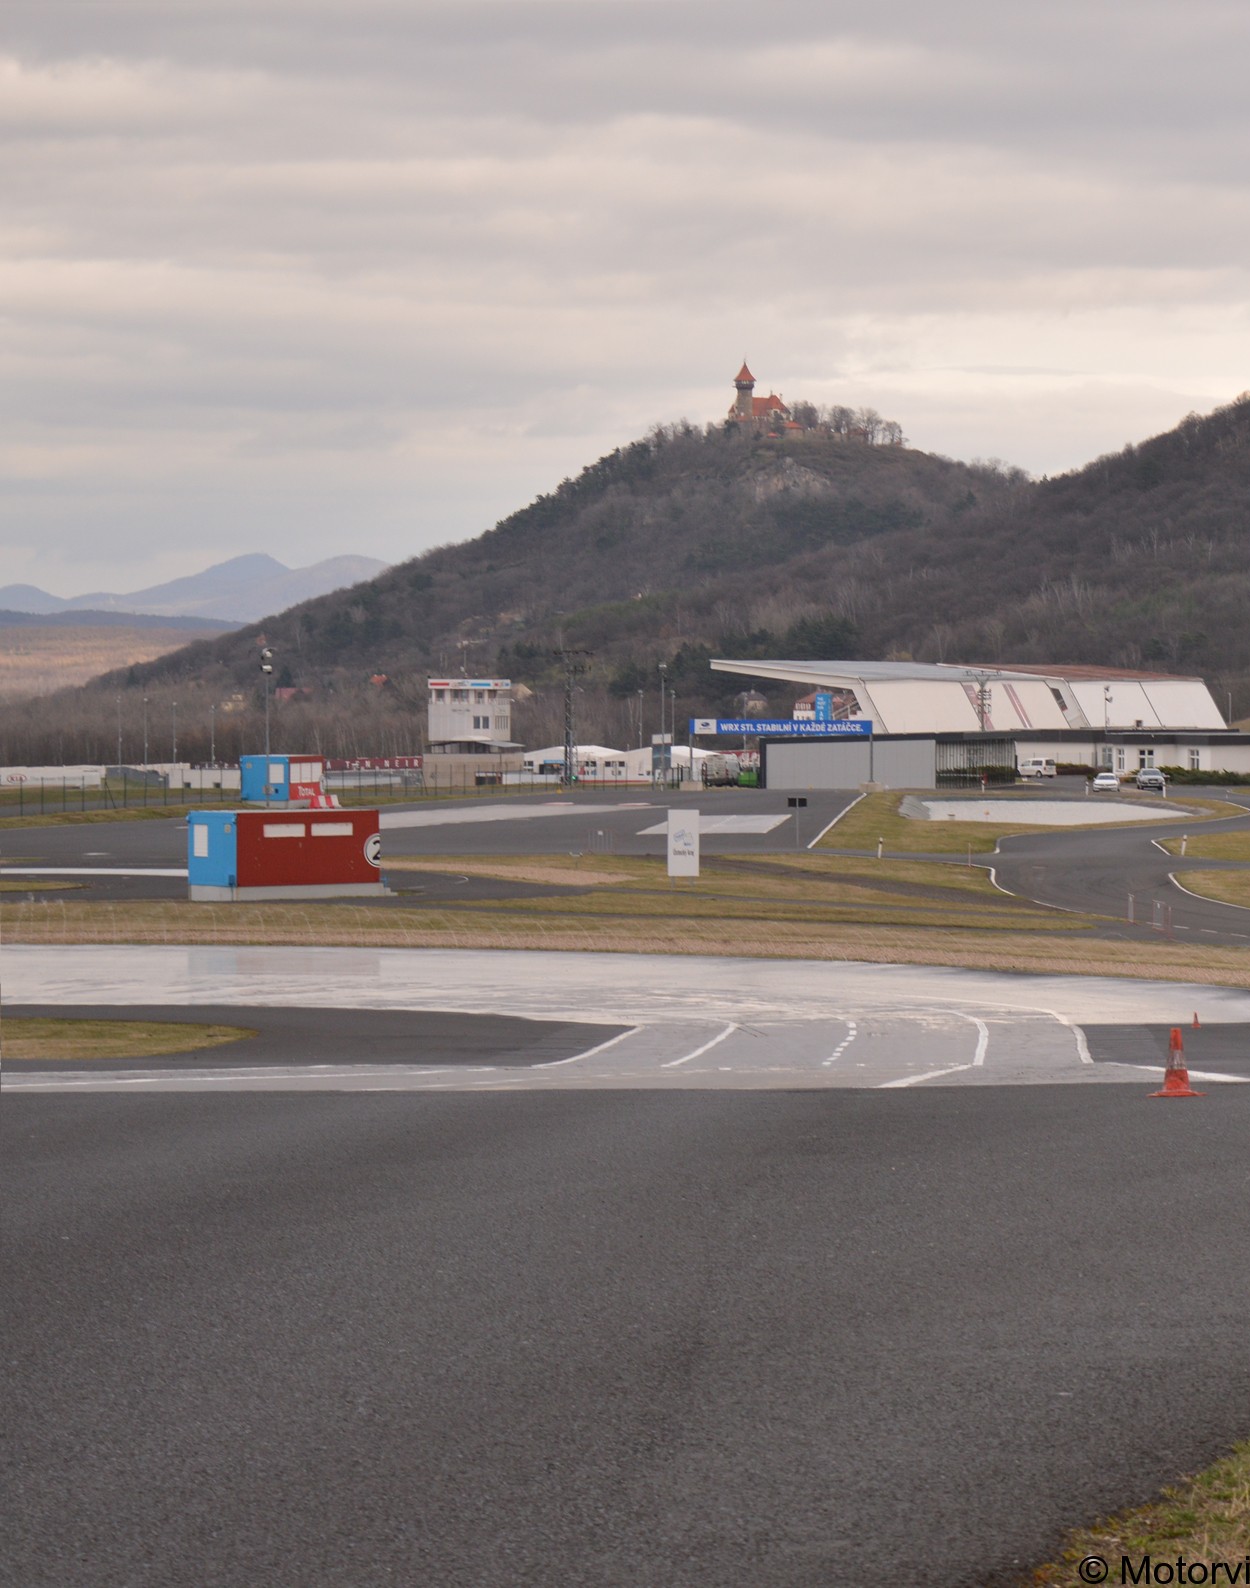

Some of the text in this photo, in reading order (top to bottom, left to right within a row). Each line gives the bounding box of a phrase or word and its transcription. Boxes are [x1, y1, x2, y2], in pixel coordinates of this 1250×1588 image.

[720, 723, 739, 732] WRX
[756, 721, 791, 732] STABILNÍ
[800, 721, 826, 732] KAŽDÉ
[372, 839, 381, 861] 2
